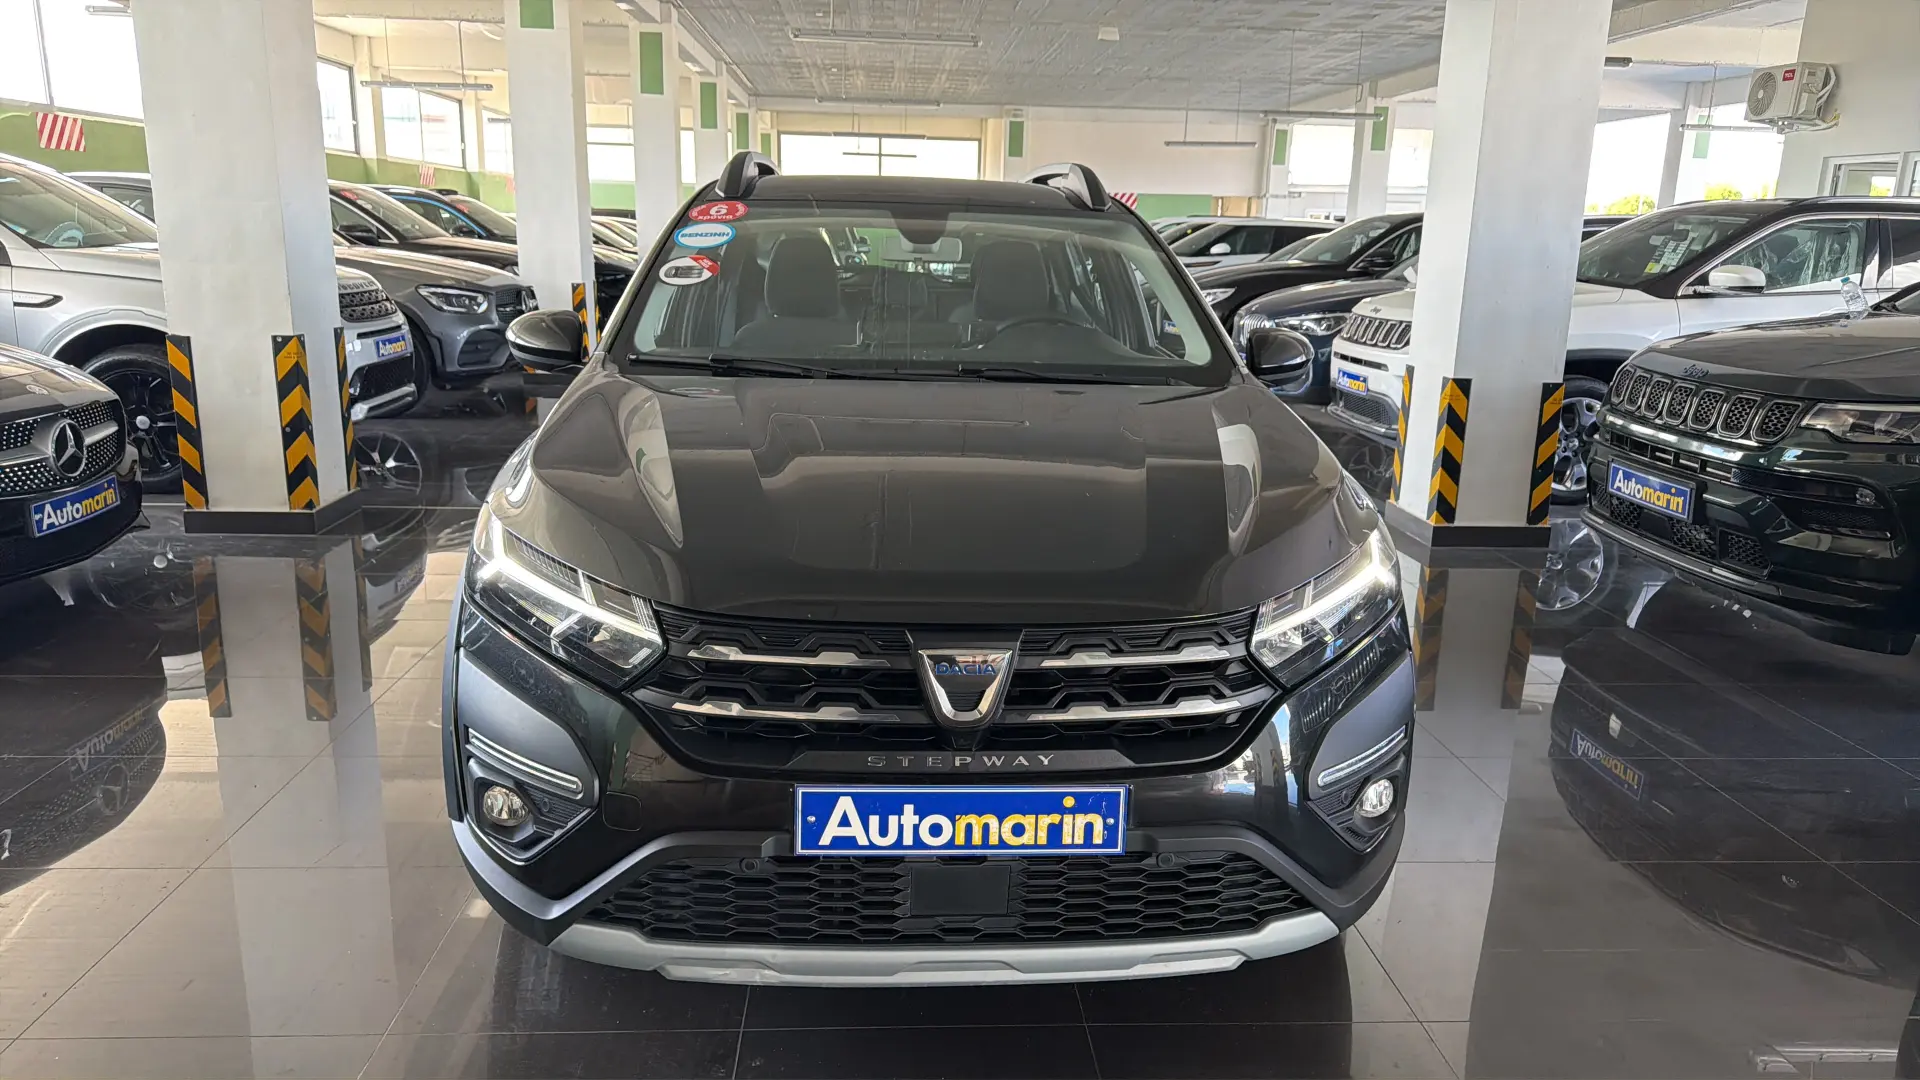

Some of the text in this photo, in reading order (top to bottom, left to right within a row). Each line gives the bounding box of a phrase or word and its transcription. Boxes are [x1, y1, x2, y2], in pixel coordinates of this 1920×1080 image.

[709, 205, 728, 215] 6
[379, 335, 407, 357] Automarin
[1613, 469, 1684, 513] Automarin
[42, 482, 116, 531] Automarin
[935, 663, 997, 675] DACIA
[867, 754, 1054, 767] STEPWAY
[818, 795, 1104, 847] Automarin
